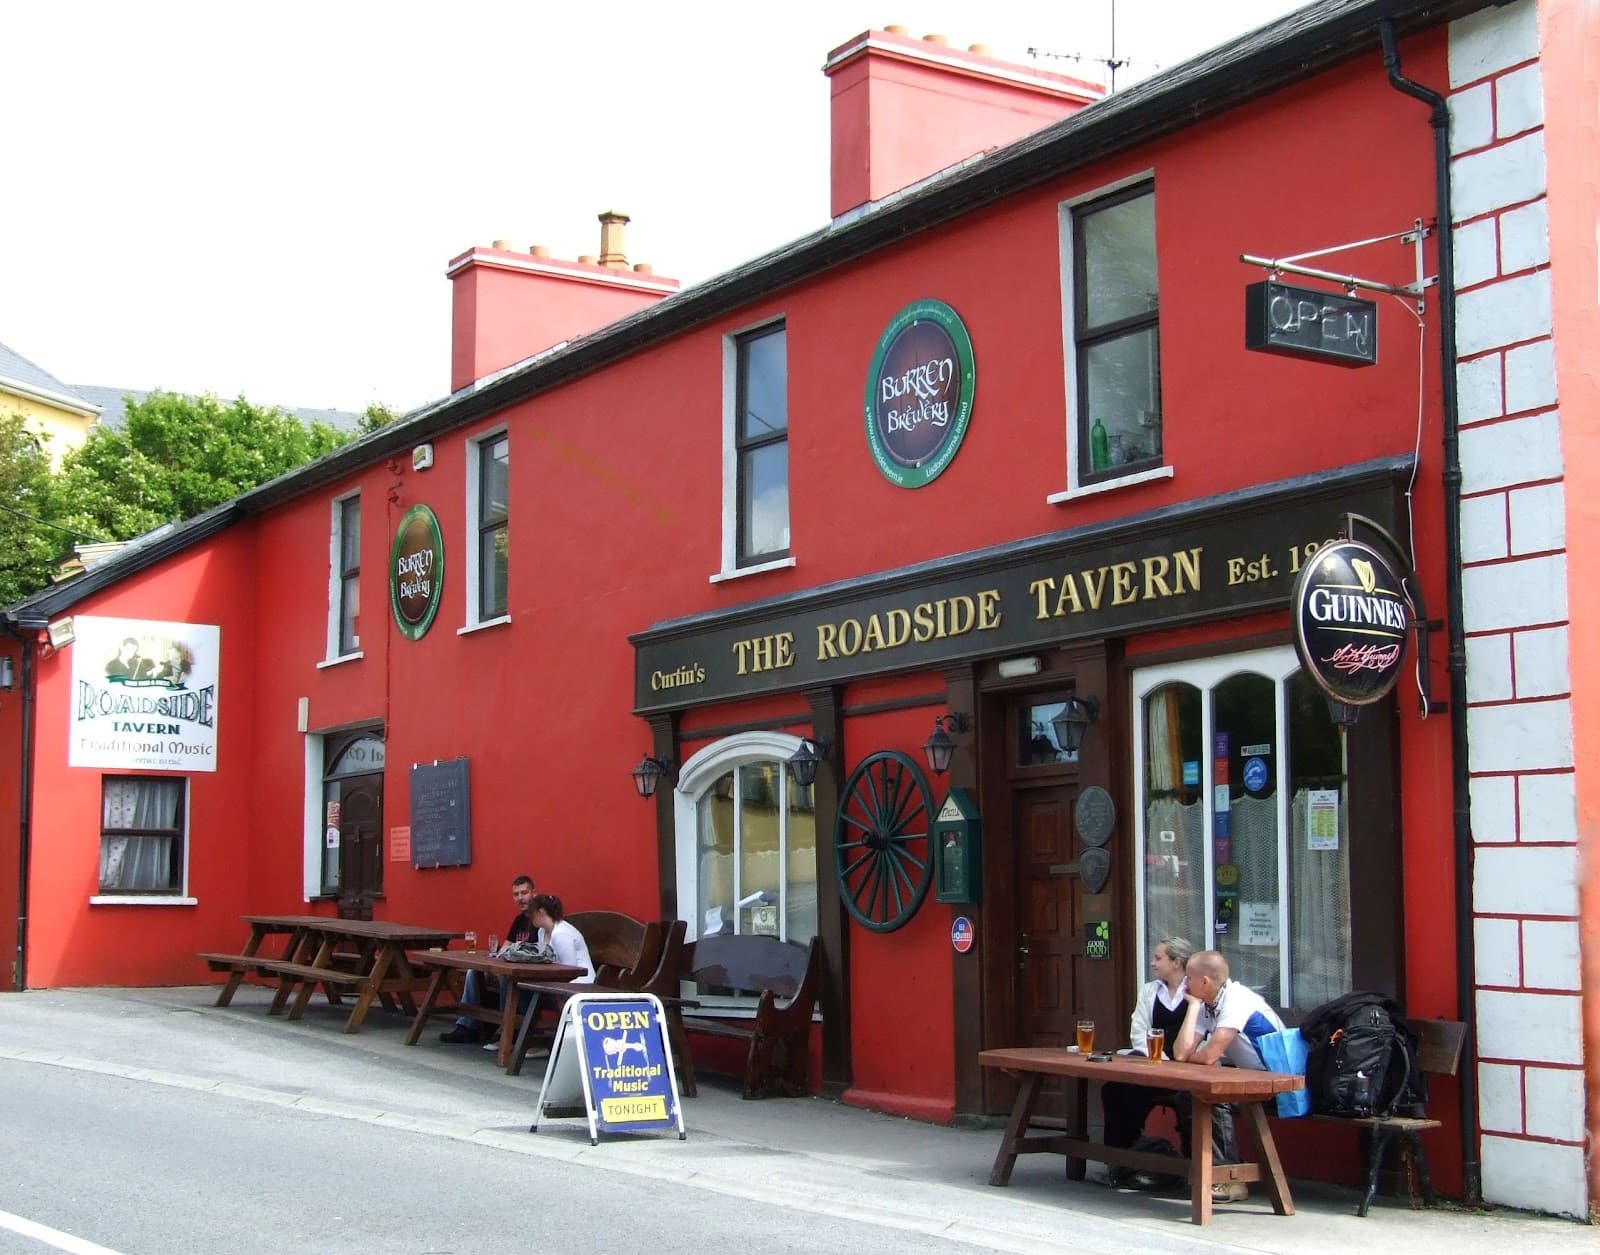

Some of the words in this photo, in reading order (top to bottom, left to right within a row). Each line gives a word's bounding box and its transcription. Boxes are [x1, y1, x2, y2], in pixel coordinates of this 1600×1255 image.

[1270, 296, 1368, 351] OPEN
[732, 632, 795, 676] THE
[816, 589, 1002, 661] ROADSIDE
[1029, 547, 1203, 620] TAVERN
[1227, 555, 1279, 585] Est.
[1309, 588, 1405, 630] GUINNESS
[78, 680, 214, 727] ROADSIDE
[112, 721, 180, 735] TAVERN
[81, 738, 164, 753] Traditional
[168, 741, 212, 755] Music
[1087, 946, 1106, 955] FOOD
[1088, 940, 1105, 948] GOOD
[587, 1011, 649, 1030] OPEN
[593, 1064, 661, 1079] Traditional
[613, 1080, 649, 1093] Music
[607, 1103, 658, 1115] TONIGHT
